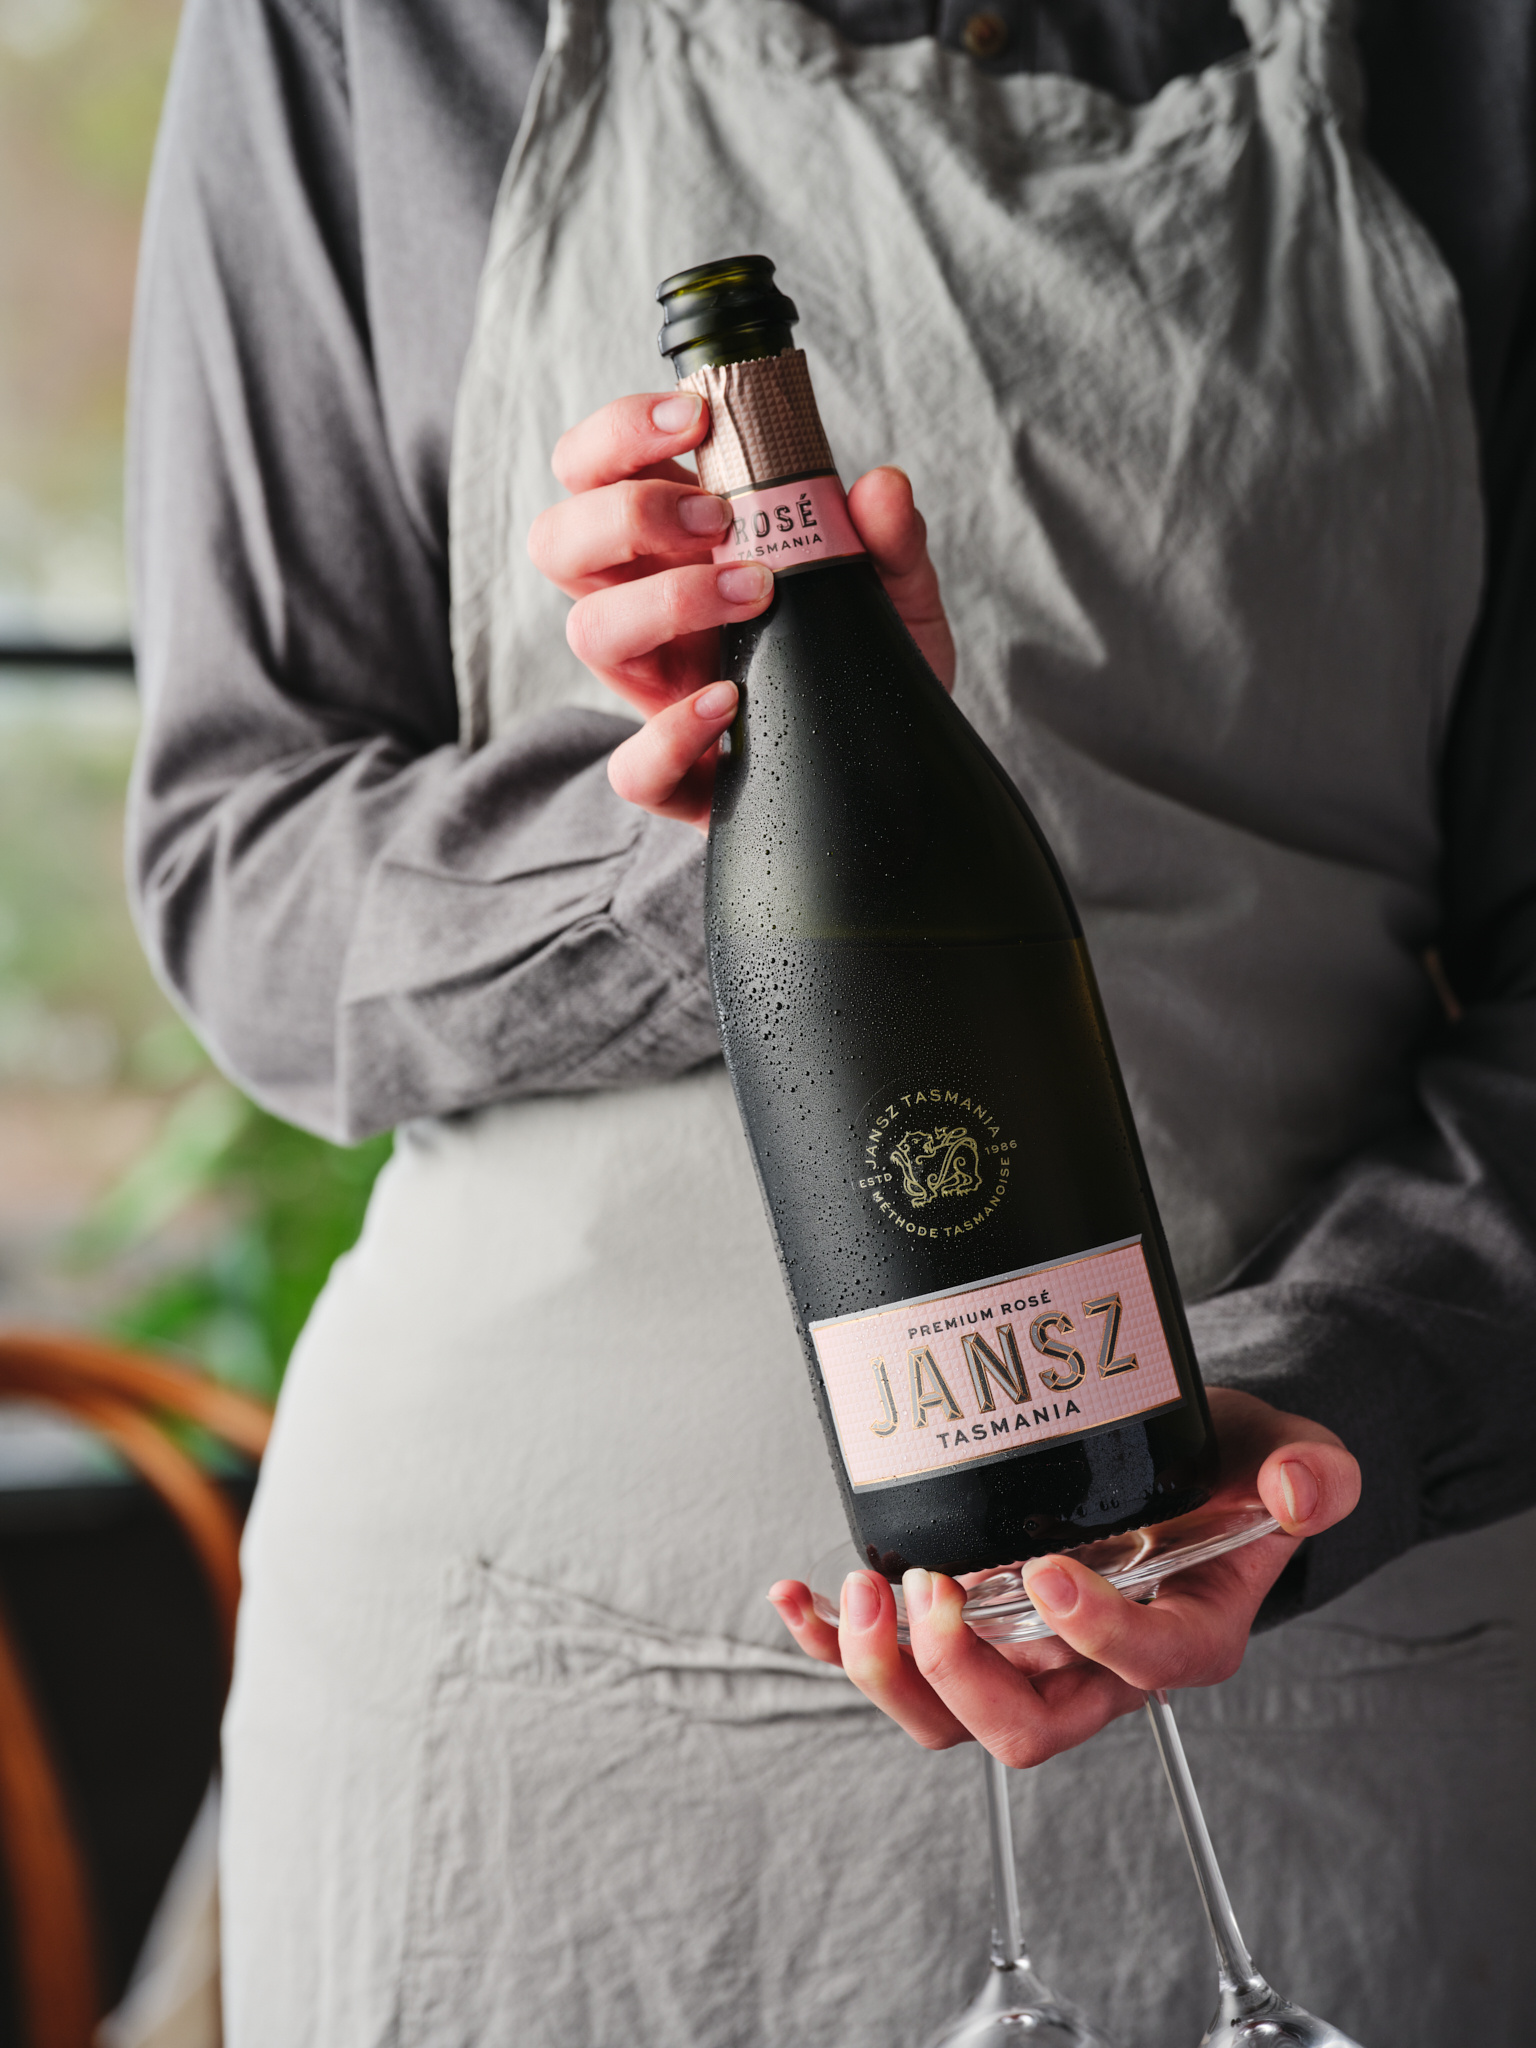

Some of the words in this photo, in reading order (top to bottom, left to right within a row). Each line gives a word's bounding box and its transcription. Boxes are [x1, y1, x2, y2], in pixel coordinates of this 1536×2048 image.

[732, 493, 817, 545] ROSÉ
[737, 533, 823, 561] TASMANIA
[865, 1104, 899, 1170] JANSZ
[900, 1089, 1000, 1138] TASMANIA
[985, 1139, 1018, 1155] 1986
[859, 1173, 892, 1188] ESTD
[944, 1157, 1010, 1236] TASMANOISE
[908, 1306, 994, 1340] PREMIUM
[1001, 1289, 1052, 1316] ROSÉ
[869, 1292, 1139, 1438] JANSZ
[936, 1399, 1081, 1449] TASMANIA
